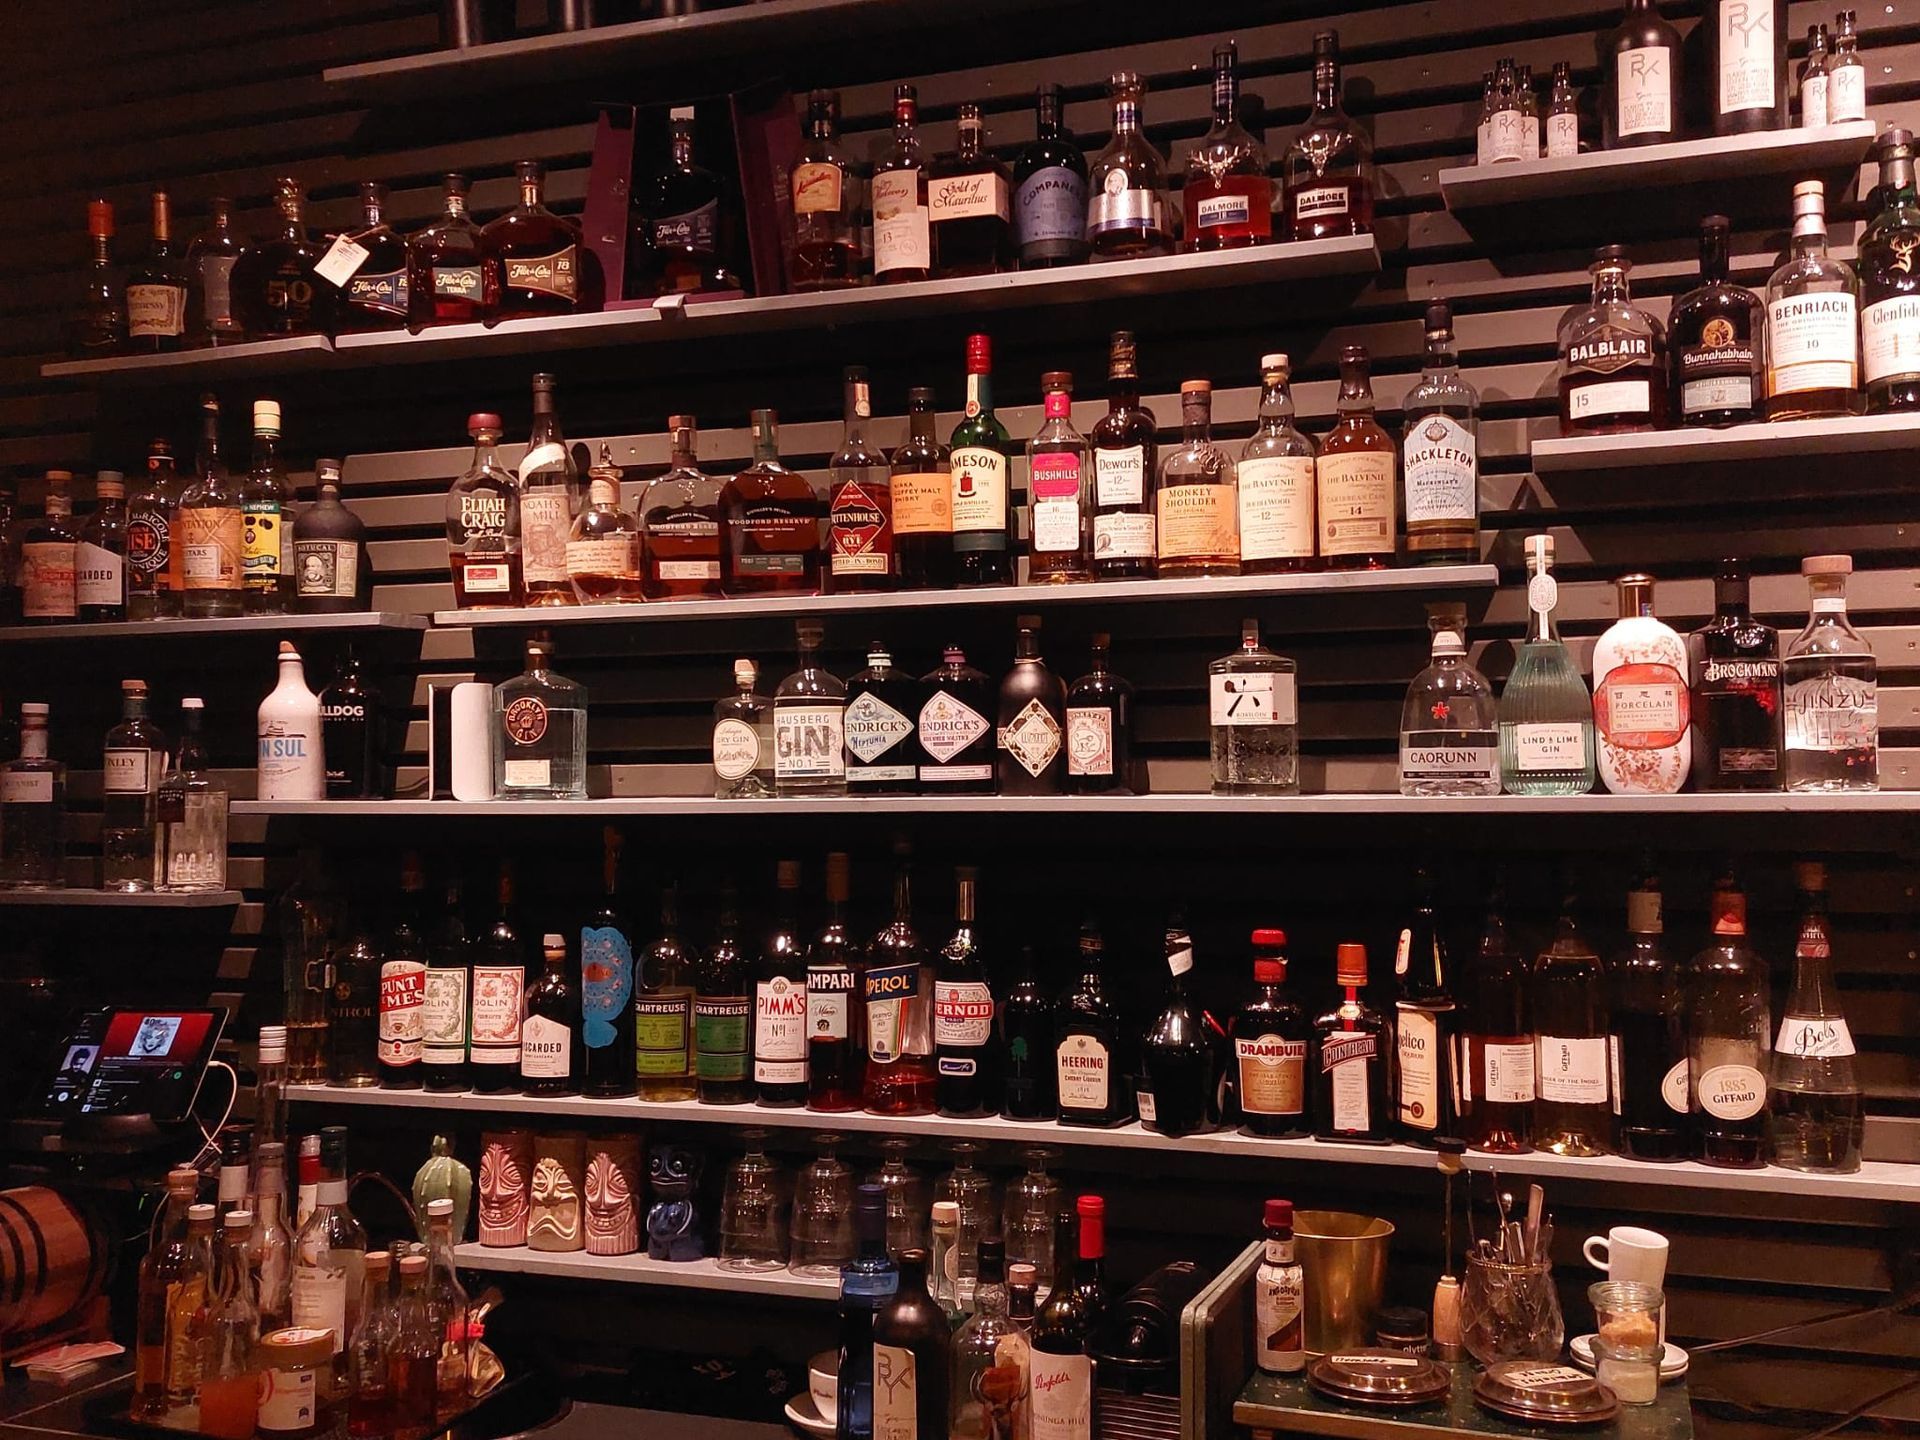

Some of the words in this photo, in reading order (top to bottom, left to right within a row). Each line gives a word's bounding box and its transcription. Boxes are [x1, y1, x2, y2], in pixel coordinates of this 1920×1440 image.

[1299, 192, 1345, 206] DALMORE
[1201, 201, 1244, 213] DALMORE
[510, 264, 529, 279] Flor
[1775, 300, 1848, 321] BENRIACH
[1570, 338, 1647, 363] BALBLAIR
[1807, 340, 1819, 349] 10
[1683, 347, 1754, 365] Bunnahabhain
[1575, 394, 1589, 408] 15
[1099, 457, 1140, 471] Dewar's
[1406, 447, 1474, 472] SHACKLETON
[1034, 469, 1078, 480] BUSHMILLS
[1341, 472, 1385, 483] BALVENIE
[1169, 487, 1212, 498] MONKEY
[461, 497, 506, 512] ELIJAH
[1165, 497, 1217, 508] SHOULDER
[1260, 512, 1272, 520] 12
[1350, 506, 1363, 515] 14
[461, 512, 506, 528] CRAIG
[728, 518, 772, 526] WOODFORD
[773, 517, 810, 525] RESERVE
[842, 536, 862, 546] RYE
[1709, 661, 1778, 682] BROCKMANS
[508, 700, 545, 722] BROOKLYN
[1615, 700, 1674, 710] PORCELAIN
[1798, 694, 1866, 715] JINZU
[516, 728, 538, 740] GIN
[1522, 737, 1546, 745] LIND
[1556, 736, 1579, 744] LIME
[273, 739, 307, 757] SUL
[777, 726, 830, 757] GIN
[1541, 745, 1560, 753] GIN
[1410, 751, 1477, 765] CAORUNN
[381, 975, 417, 996] PUNT
[865, 976, 910, 995] APEROL
[386, 988, 424, 1010] MES
[758, 993, 805, 1016] PIMM'S
[936, 1004, 990, 1016] ERNOD
[1795, 1022, 1836, 1056] Bols
[1240, 1043, 1304, 1057] DRAMBUIE
[1062, 1055, 1103, 1069] HEERING
[1719, 1079, 1747, 1092] 1885
[1712, 1092, 1756, 1104] GIFFARD
